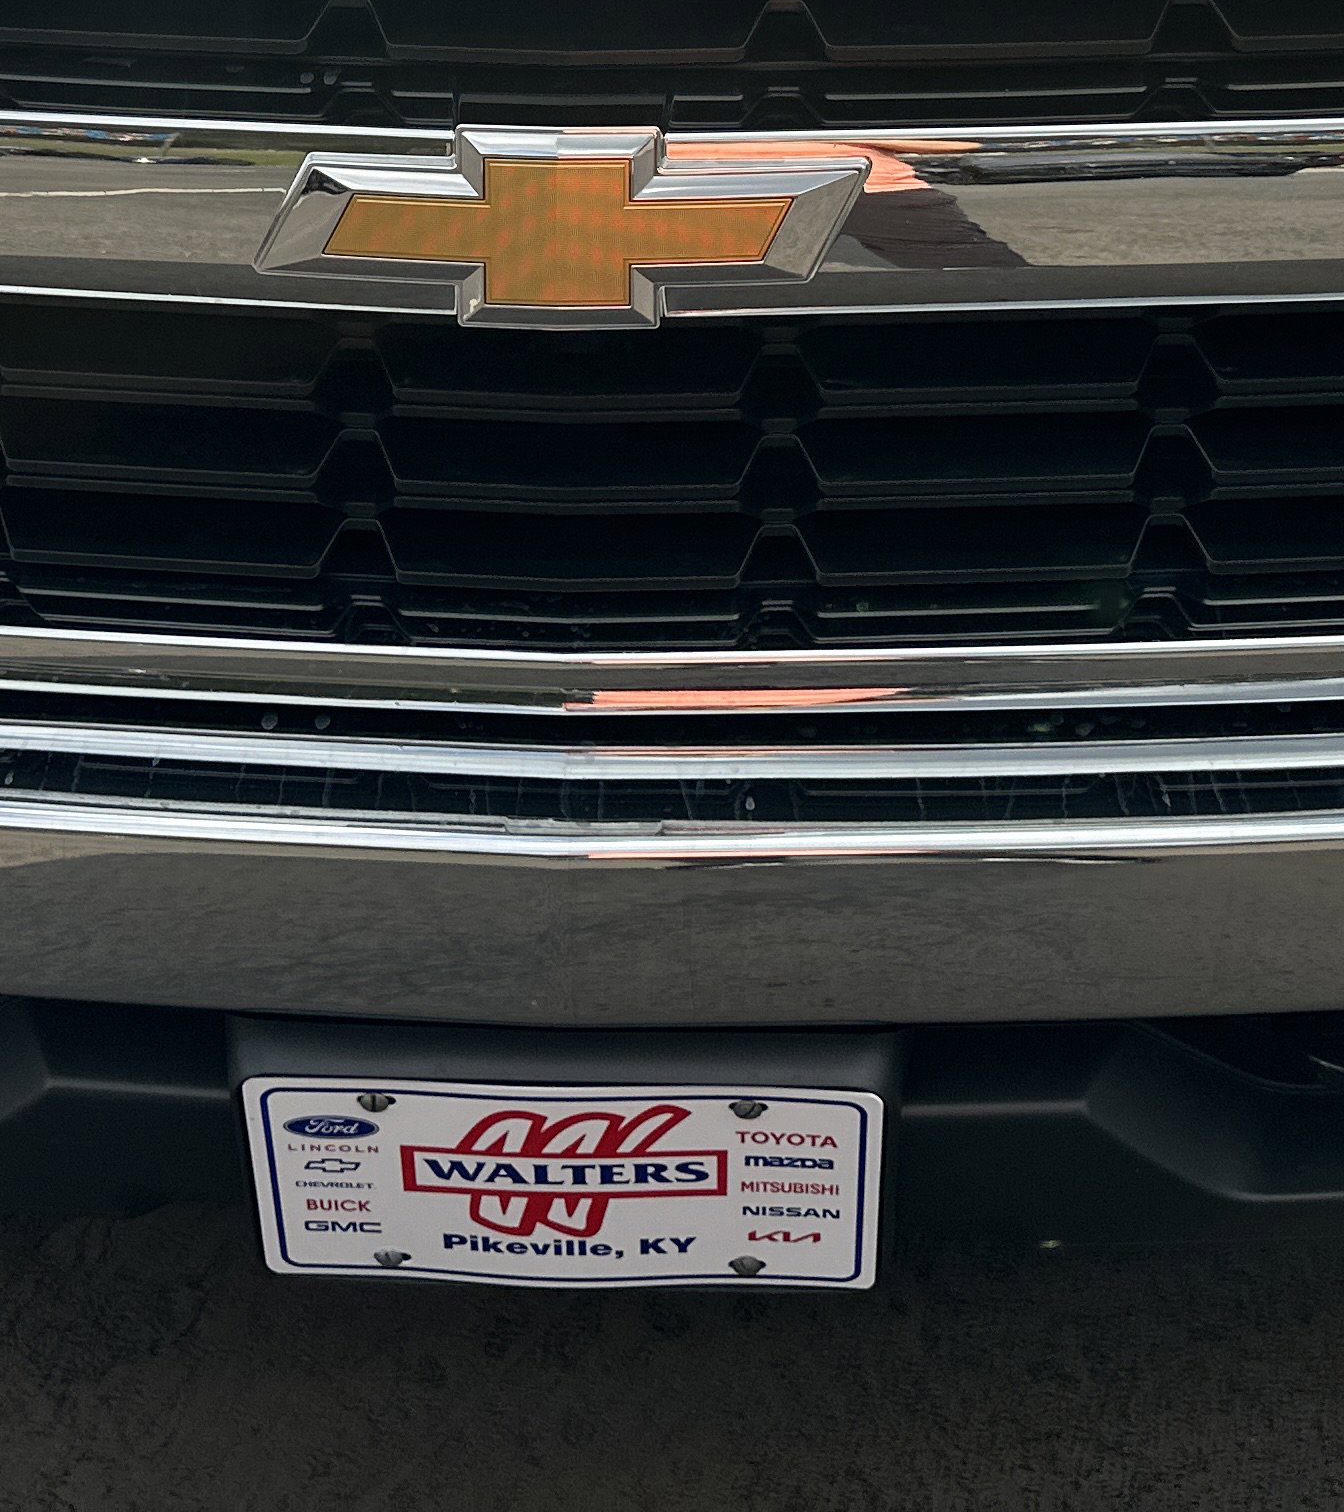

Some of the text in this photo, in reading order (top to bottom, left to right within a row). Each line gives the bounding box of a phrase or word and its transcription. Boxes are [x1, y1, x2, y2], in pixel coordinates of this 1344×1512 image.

[305, 1118, 358, 1134] Ford
[736, 1131, 838, 1148] TOYOTA
[287, 1143, 379, 1153] LINCOLN
[423, 1158, 710, 1186] WALTERS
[295, 1180, 374, 1189] CHEVROLET
[741, 1181, 840, 1196] MITSUBISHI
[306, 1198, 372, 1212] BUICK
[742, 1206, 841, 1219] NISSAN
[304, 1220, 383, 1234] GMC
[443, 1233, 697, 1259] Pikeville, KY
